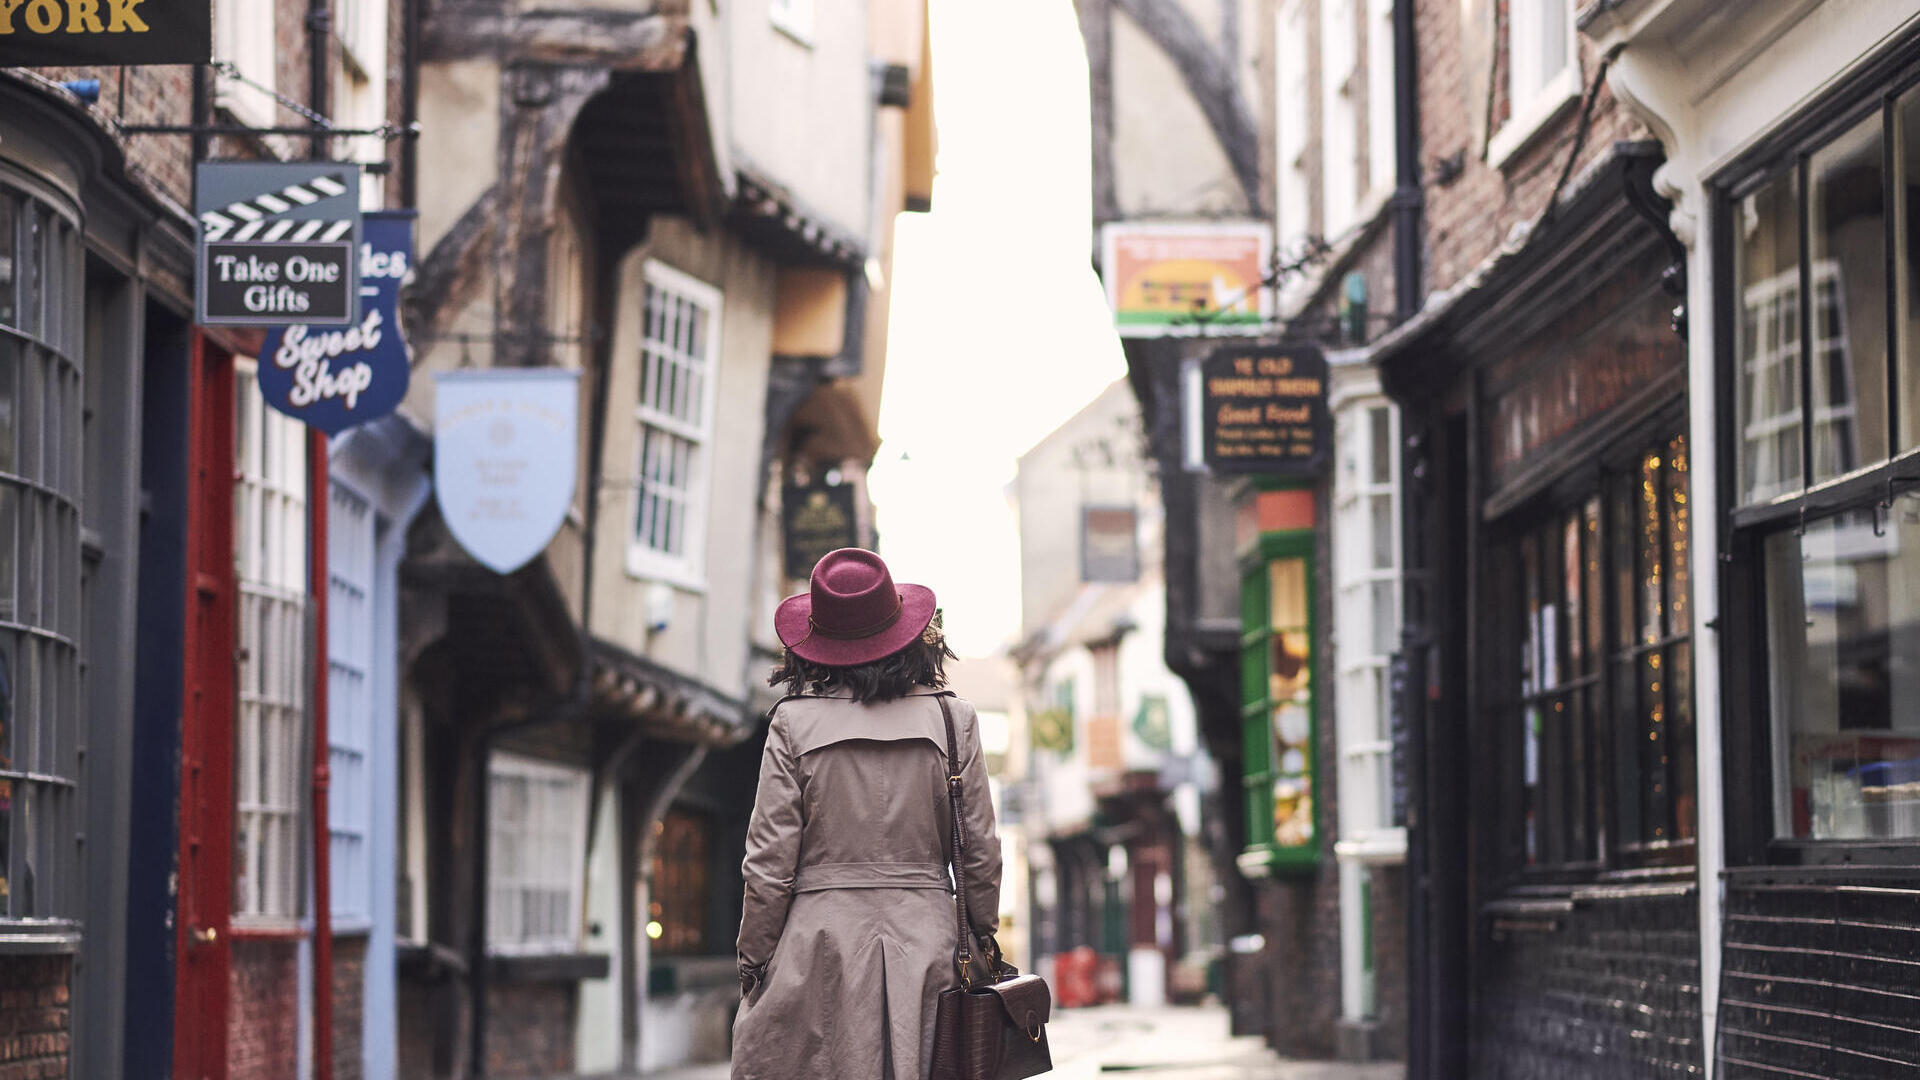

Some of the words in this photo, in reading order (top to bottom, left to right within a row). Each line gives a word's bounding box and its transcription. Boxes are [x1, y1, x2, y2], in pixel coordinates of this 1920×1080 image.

[0, 0, 149, 34] YORK
[215, 254, 279, 282] Take
[285, 255, 339, 282] One
[244, 284, 309, 312] Gifts
[275, 308, 382, 367] Sweet
[289, 357, 372, 409] Shop
